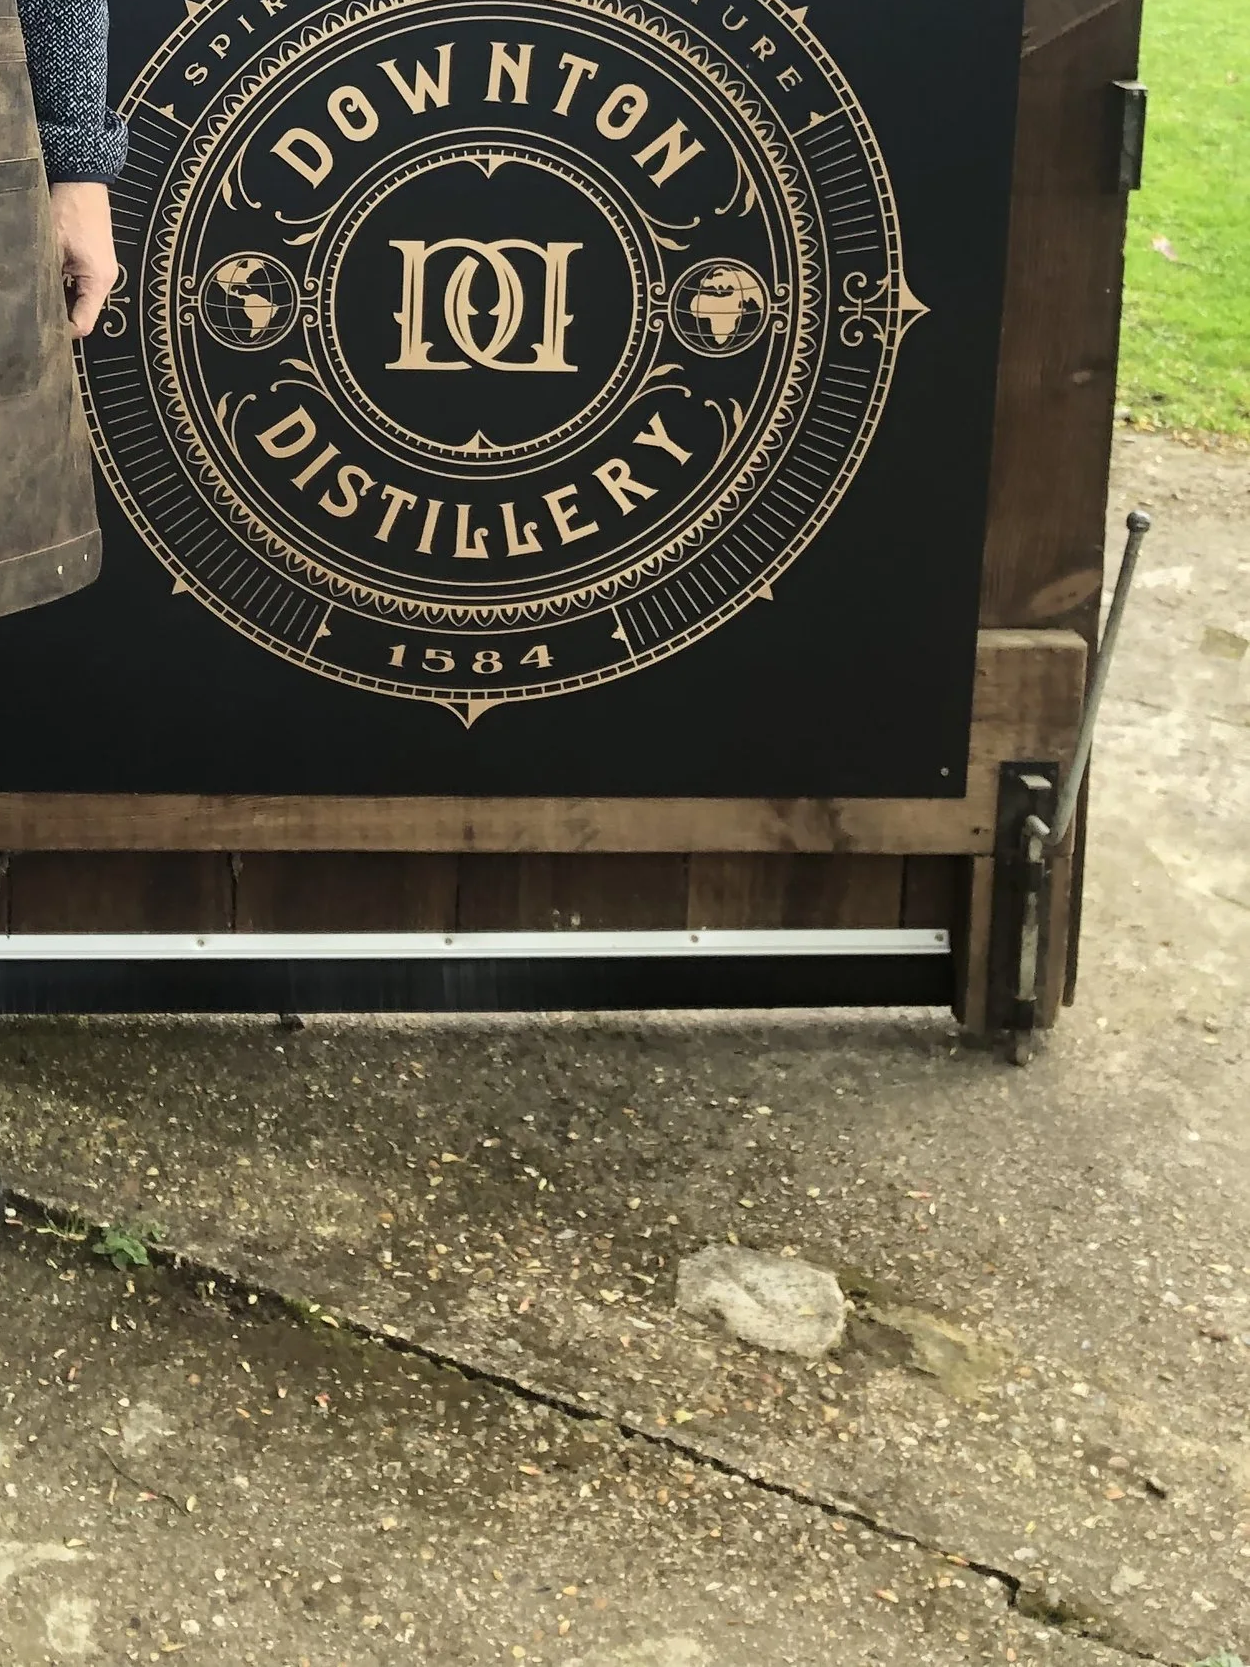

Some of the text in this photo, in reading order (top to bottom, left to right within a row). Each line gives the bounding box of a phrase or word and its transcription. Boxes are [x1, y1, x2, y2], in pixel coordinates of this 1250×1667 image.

[270, 41, 706, 190] DOWNTON
[255, 405, 694, 559] DISTILLERY
[387, 644, 555, 674] 1584
